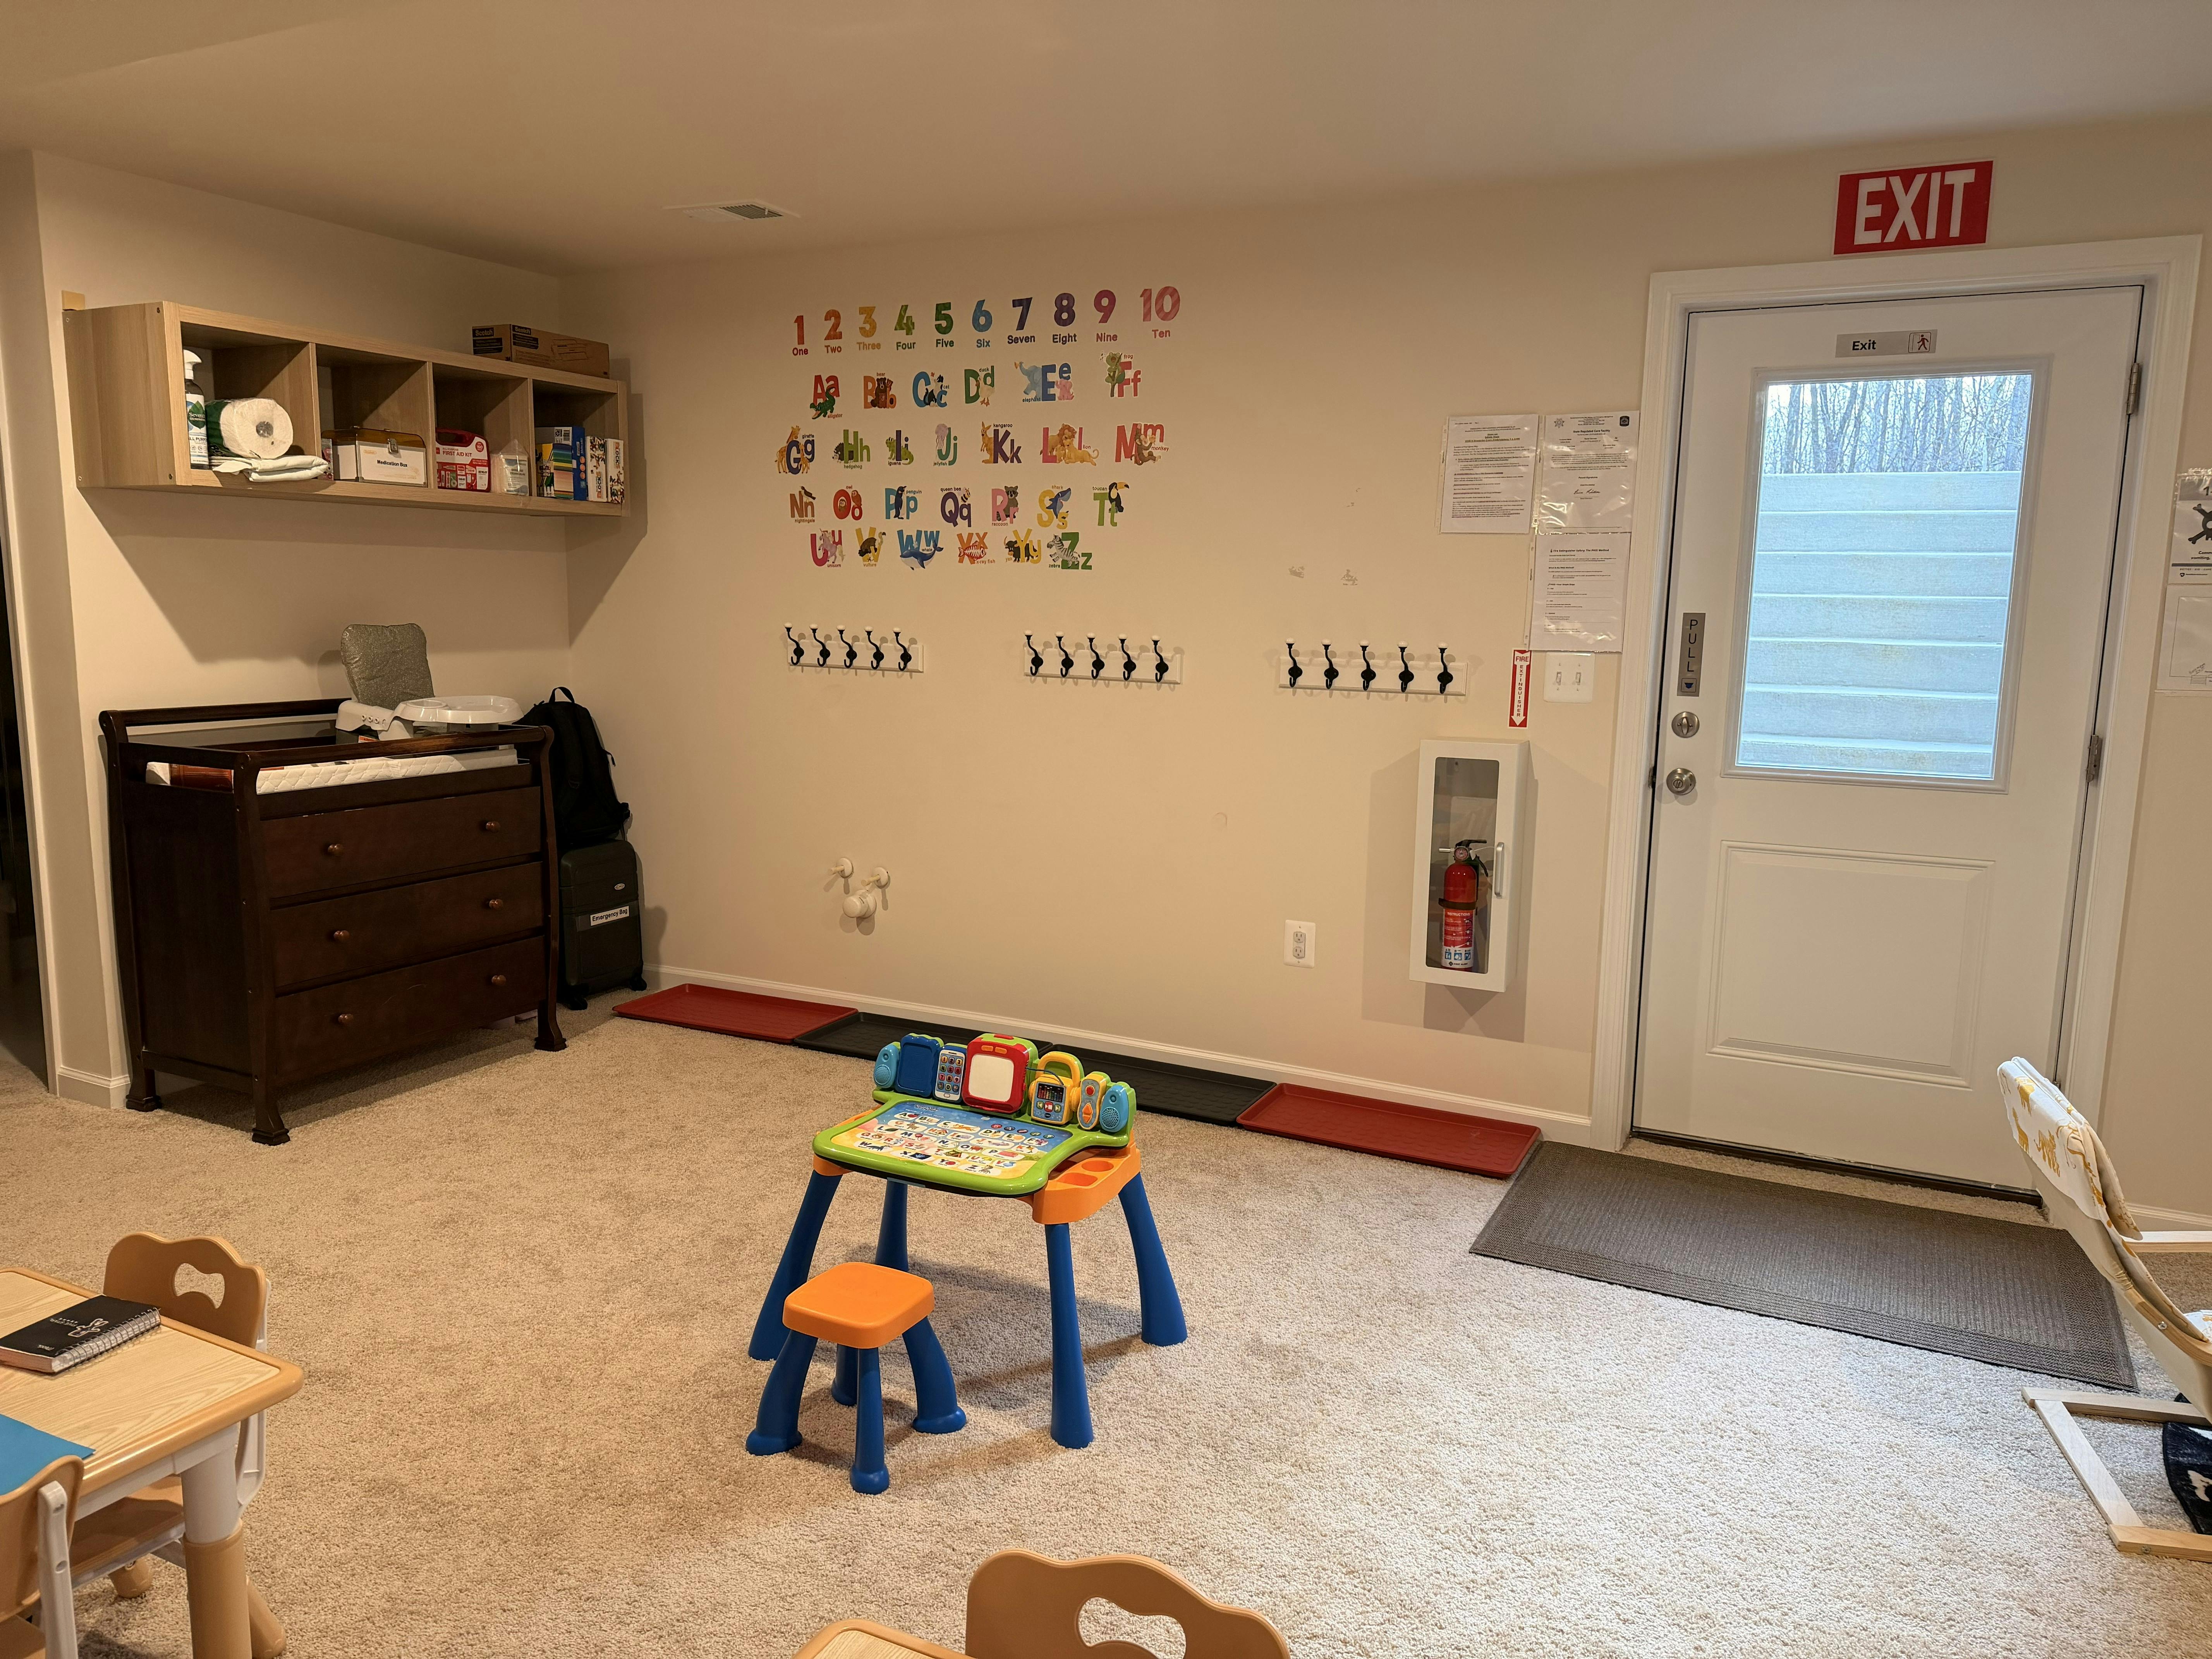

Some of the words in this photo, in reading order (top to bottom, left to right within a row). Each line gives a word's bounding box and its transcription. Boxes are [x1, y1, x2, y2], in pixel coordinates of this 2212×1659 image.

[1854, 168, 1975, 245] EXIT
[794, 315, 804, 345] 1
[824, 309, 842, 340] 2
[859, 306, 876, 338] 3
[894, 305, 915, 335] 4
[935, 302, 953, 335] 5
[972, 299, 993, 332] 6
[1012, 297, 1033, 331] 7
[1054, 292, 1075, 326] 8
[1094, 289, 1116, 323] 9
[1140, 286, 1180, 322] 10
[792, 347, 808, 356] One
[824, 345, 842, 353] Two
[857, 342, 881, 350] Three
[896, 341, 916, 350] Four
[936, 338, 954, 347] Five
[976, 339, 990, 348] Six
[1007, 335, 1036, 345] Seven
[1052, 333, 1077, 345] Eight
[1096, 333, 1118, 342] Nine
[1152, 329, 1170, 338] Ten
[1852, 339, 1876, 350] Exit
[813, 375, 840, 408] Aa
[864, 376, 896, 409] Bb
[912, 371, 948, 408] Cc
[964, 365, 995, 404] Dd
[1041, 362, 1071, 402] Ee
[1118, 361, 1141, 398] Ff
[786, 439, 815, 475] Gg
[843, 429, 871, 464] Hh
[938, 427, 958, 466] Jj
[993, 429, 1022, 464] Kk
[1115, 423, 1164, 464] Mm
[790, 491, 815, 518] Nn
[833, 489, 862, 520] Oo
[885, 488, 918, 519] Pp
[941, 492, 971, 527] Qq
[991, 488, 1019, 524] Rr
[1037, 489, 1069, 529] Ss
[1093, 492, 1118, 527] Tt
[1687, 620, 1698, 672] PULL
[592, 912, 618, 921] Emergency
